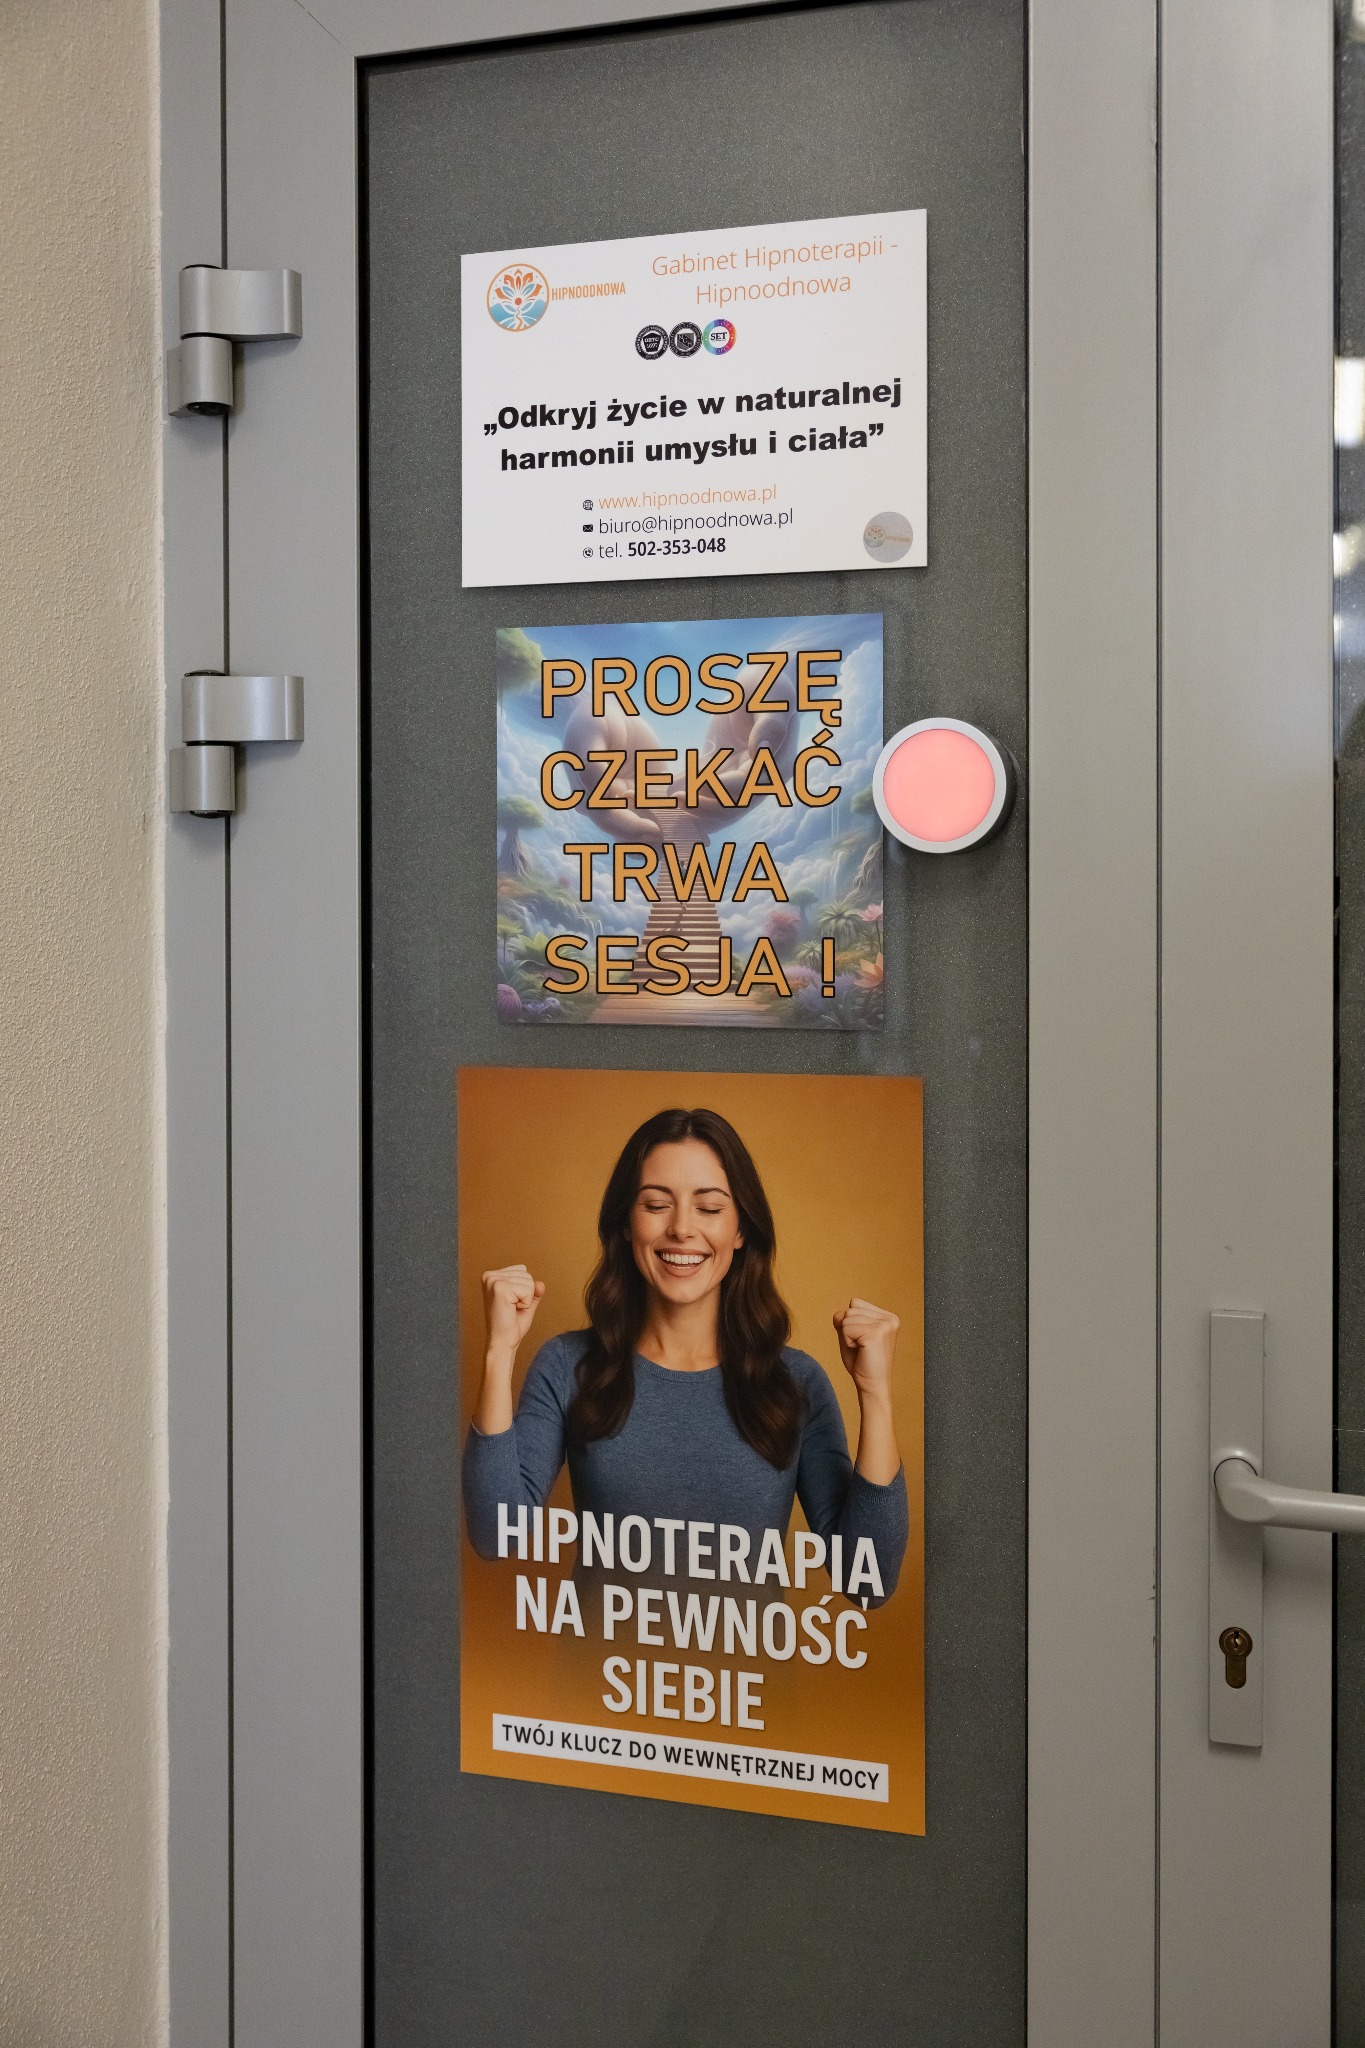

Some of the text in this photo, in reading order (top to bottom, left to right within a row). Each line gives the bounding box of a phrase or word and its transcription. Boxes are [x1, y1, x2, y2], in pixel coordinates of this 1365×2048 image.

[651, 251, 739, 277] Gabinet
[744, 235, 884, 267] Hipnoterapii
[551, 281, 627, 302] HIPNOODNOWA
[696, 273, 852, 308] Hipnoodnowa
[710, 331, 728, 341] SET
[483, 378, 903, 437] „Odkryj życie w naturalnej
[501, 422, 885, 471] harmonii umysłu i ciała”
[598, 484, 778, 511] www.hipnoodnowa.pl
[599, 508, 795, 535] biuro@hipnoodnowa.pl
[598, 537, 727, 559] tel. 502-353-048
[541, 650, 842, 727] PROSZĘ
[541, 728, 842, 810] CZEKAĆ
[564, 842, 789, 902] TRWA
[543, 935, 792, 998] SESJA
[515, 1574, 586, 1638] NA
[601, 1655, 766, 1731] SIEBIE
[501, 1723, 880, 1791] TWÓJ KLUCZ DO WEWNĘTRZNEJ MOCY
